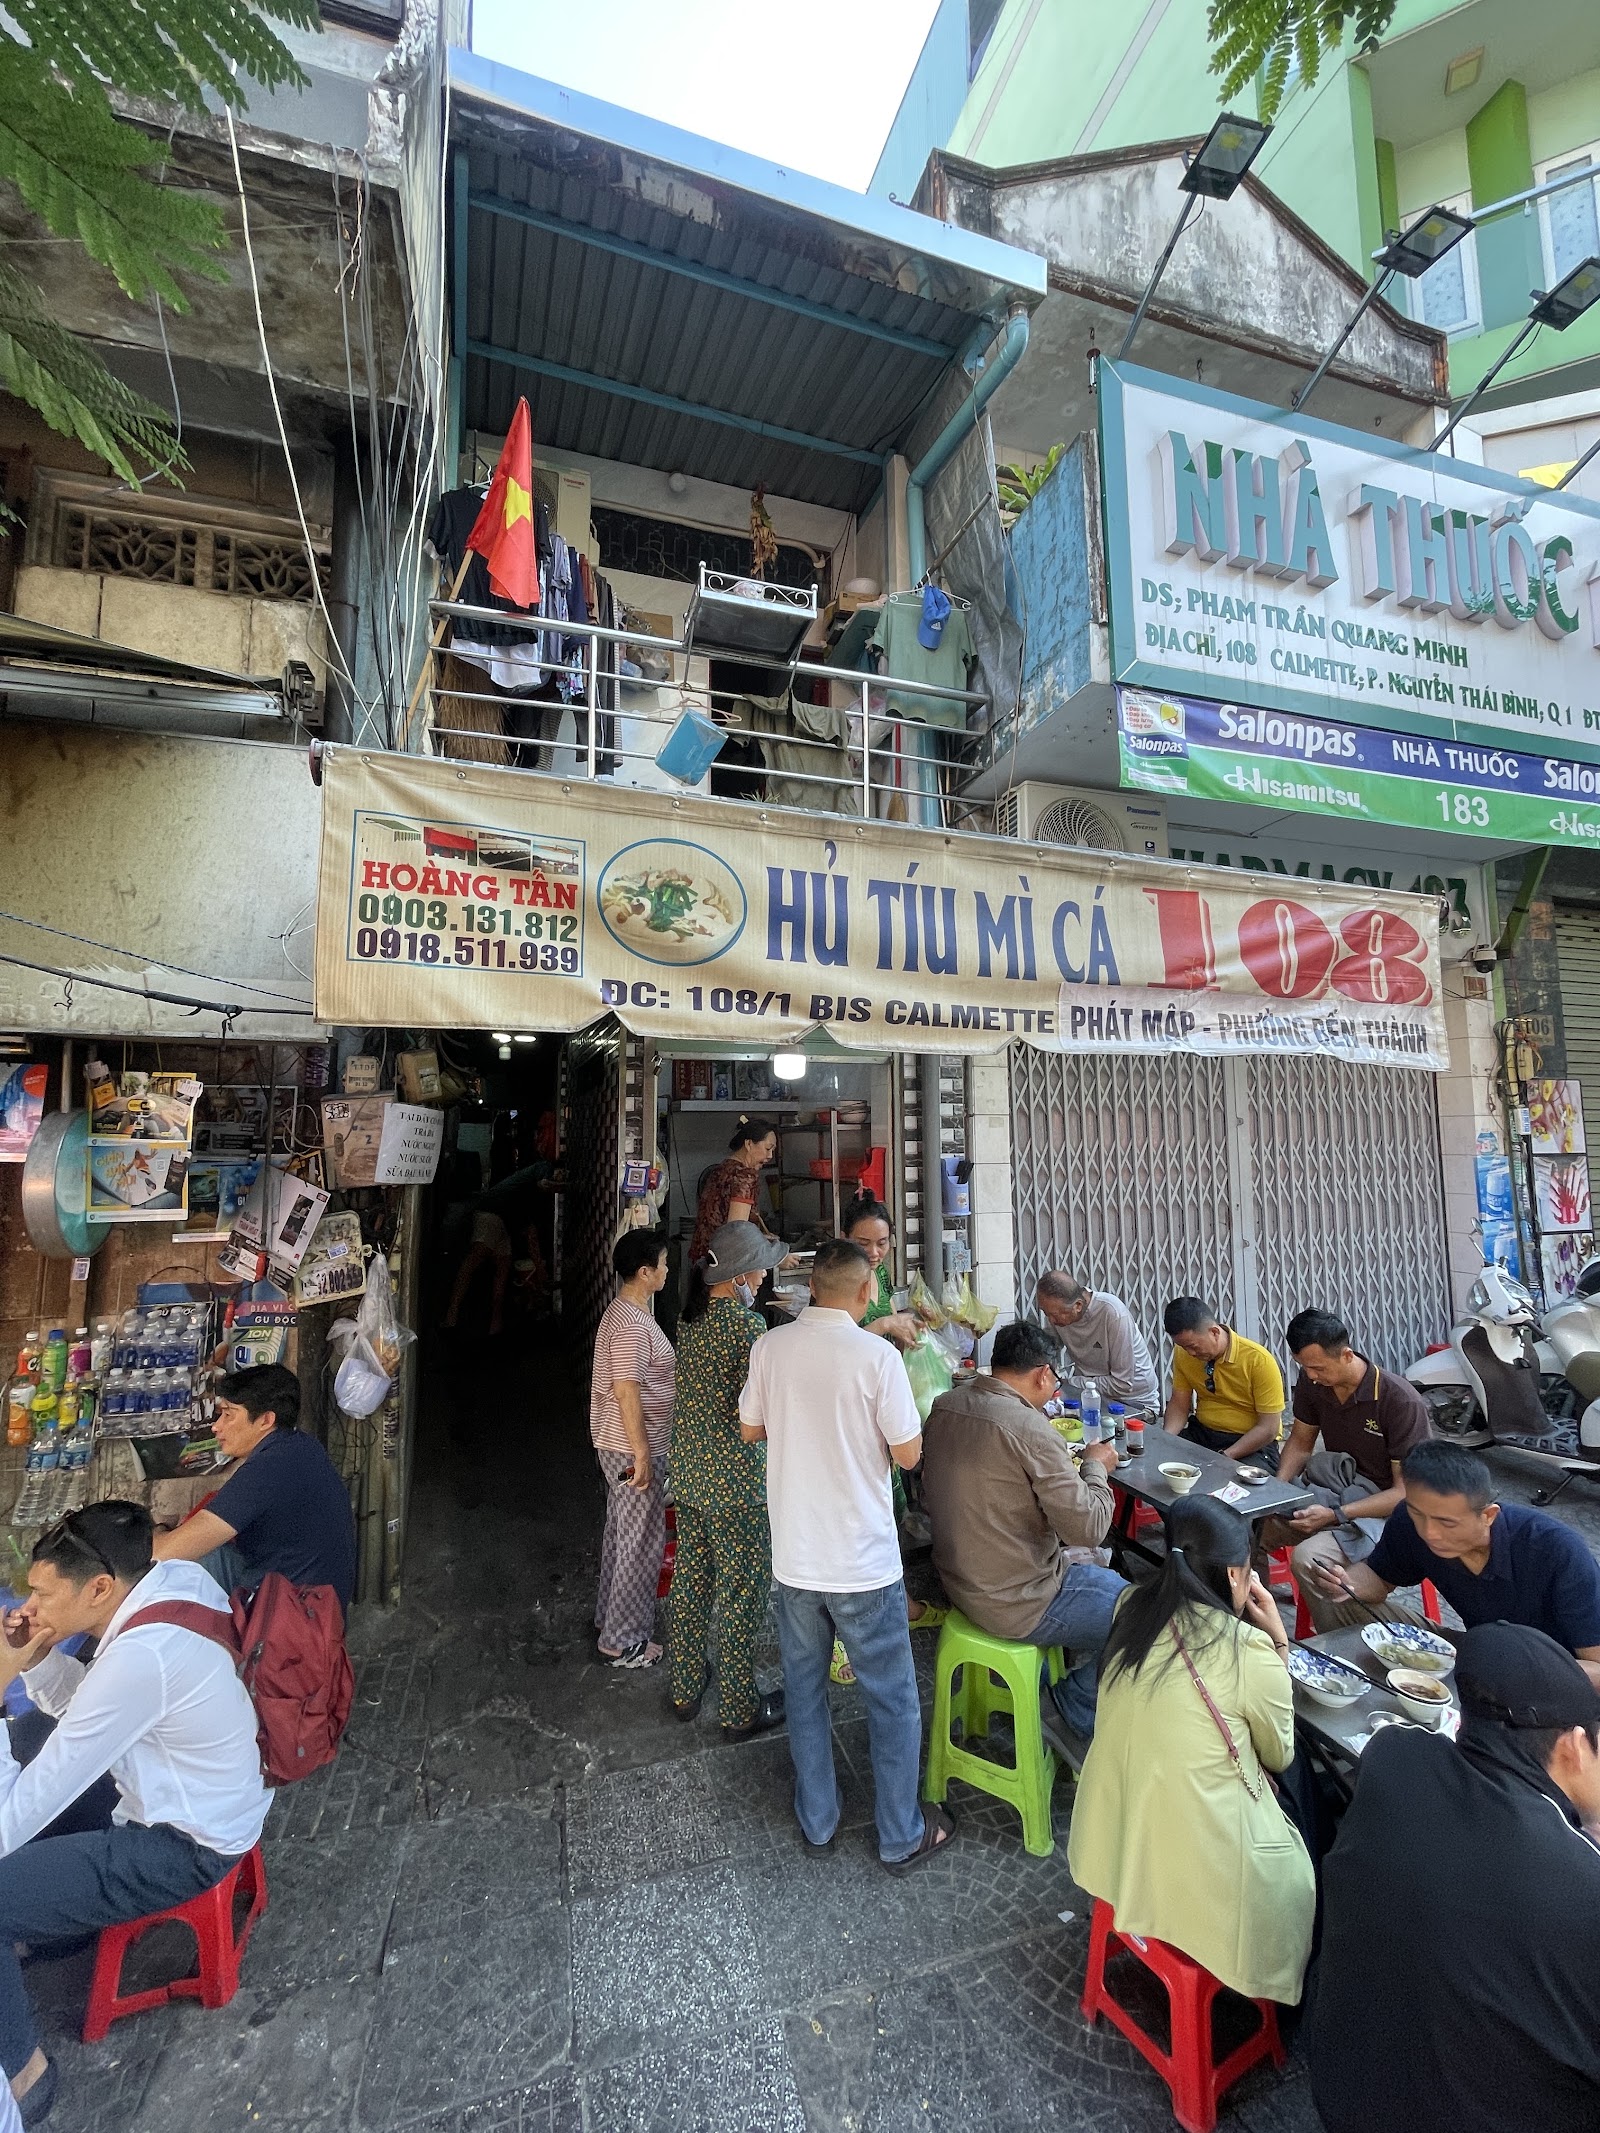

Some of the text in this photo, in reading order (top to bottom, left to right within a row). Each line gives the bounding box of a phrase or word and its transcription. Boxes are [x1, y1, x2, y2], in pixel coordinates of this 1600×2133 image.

[1156, 430, 1338, 588] NHÀ
[1348, 483, 1580, 640] THUỐC
[1187, 588, 1257, 625] PHẠM
[1261, 604, 1327, 640] TRẦN
[1331, 619, 1408, 656] QUANG
[1413, 637, 1469, 668] MINH
[1226, 640, 1258, 666] 108
[1387, 672, 1455, 705] NGUYỄN
[1459, 685, 1498, 713] THÁI
[1547, 702, 1562, 727] Q
[1130, 736, 1183, 754] Salonpas
[1218, 704, 1357, 758] Salonpas
[1392, 739, 1519, 779] NHÀ THUỐC
[1223, 765, 1362, 808] Hisamitsu
[1436, 791, 1489, 827] 183
[361, 860, 578, 910] HOÀNG TẤN
[358, 892, 578, 943] 0903.131.812
[766, 839, 849, 967] HỦ
[867, 862, 957, 974] TÍU
[974, 876, 1038, 981] MÌ
[1052, 886, 1121, 986] CÁ
[1142, 887, 1433, 1007] 108
[356, 926, 579, 973] 0918.511.939
[600, 979, 670, 1008] ĐC:
[687, 986, 792, 1017] 108/1
[809, 994, 872, 1023] BIS
[884, 1000, 1055, 1034] CALMETTE
[1070, 1000, 1134, 1042] PHÁT
[1217, 1008, 1313, 1047] PHƯỜNG
[1362, 1014, 1430, 1054] THÀNH
[254, 1315, 270, 1324] GU
